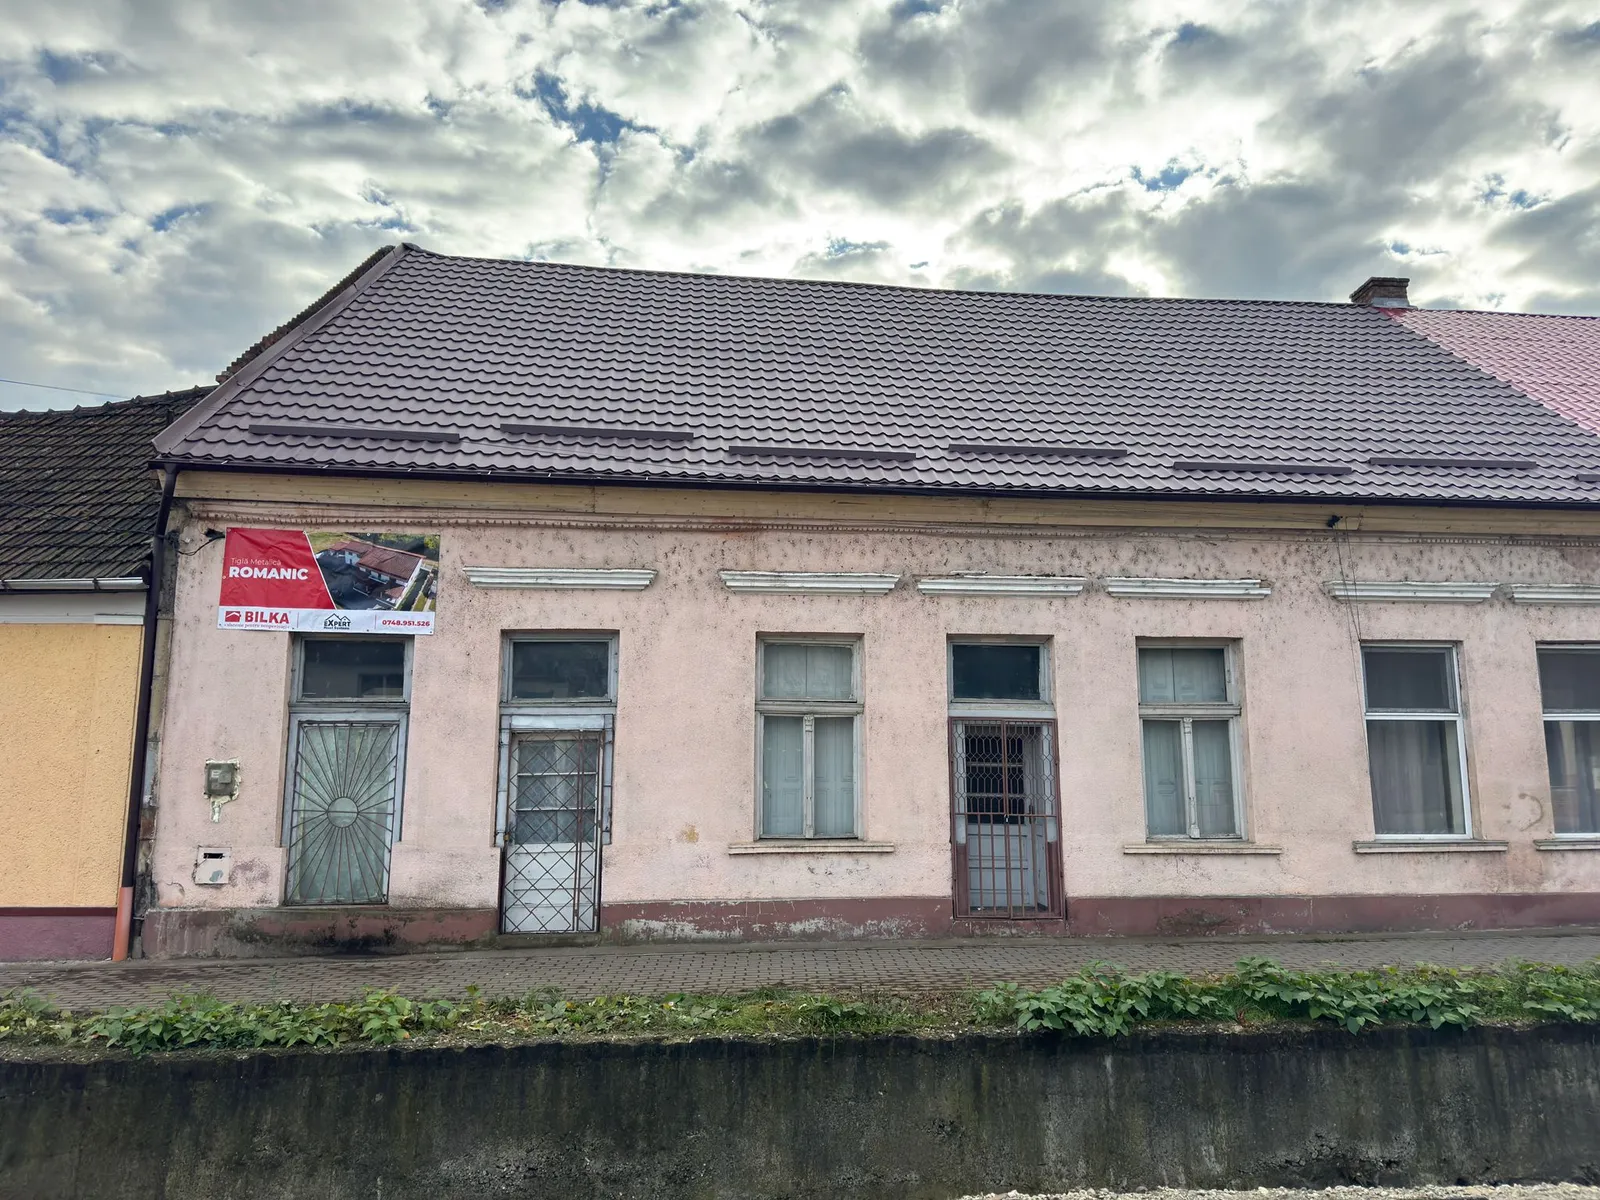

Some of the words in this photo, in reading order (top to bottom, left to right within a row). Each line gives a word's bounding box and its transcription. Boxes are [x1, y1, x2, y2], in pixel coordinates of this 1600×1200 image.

[228, 566, 309, 580] ROMANIC
[244, 610, 290, 624] BILKA
[323, 619, 351, 627] EXPERT
[381, 619, 431, 627] 0748.951.526
